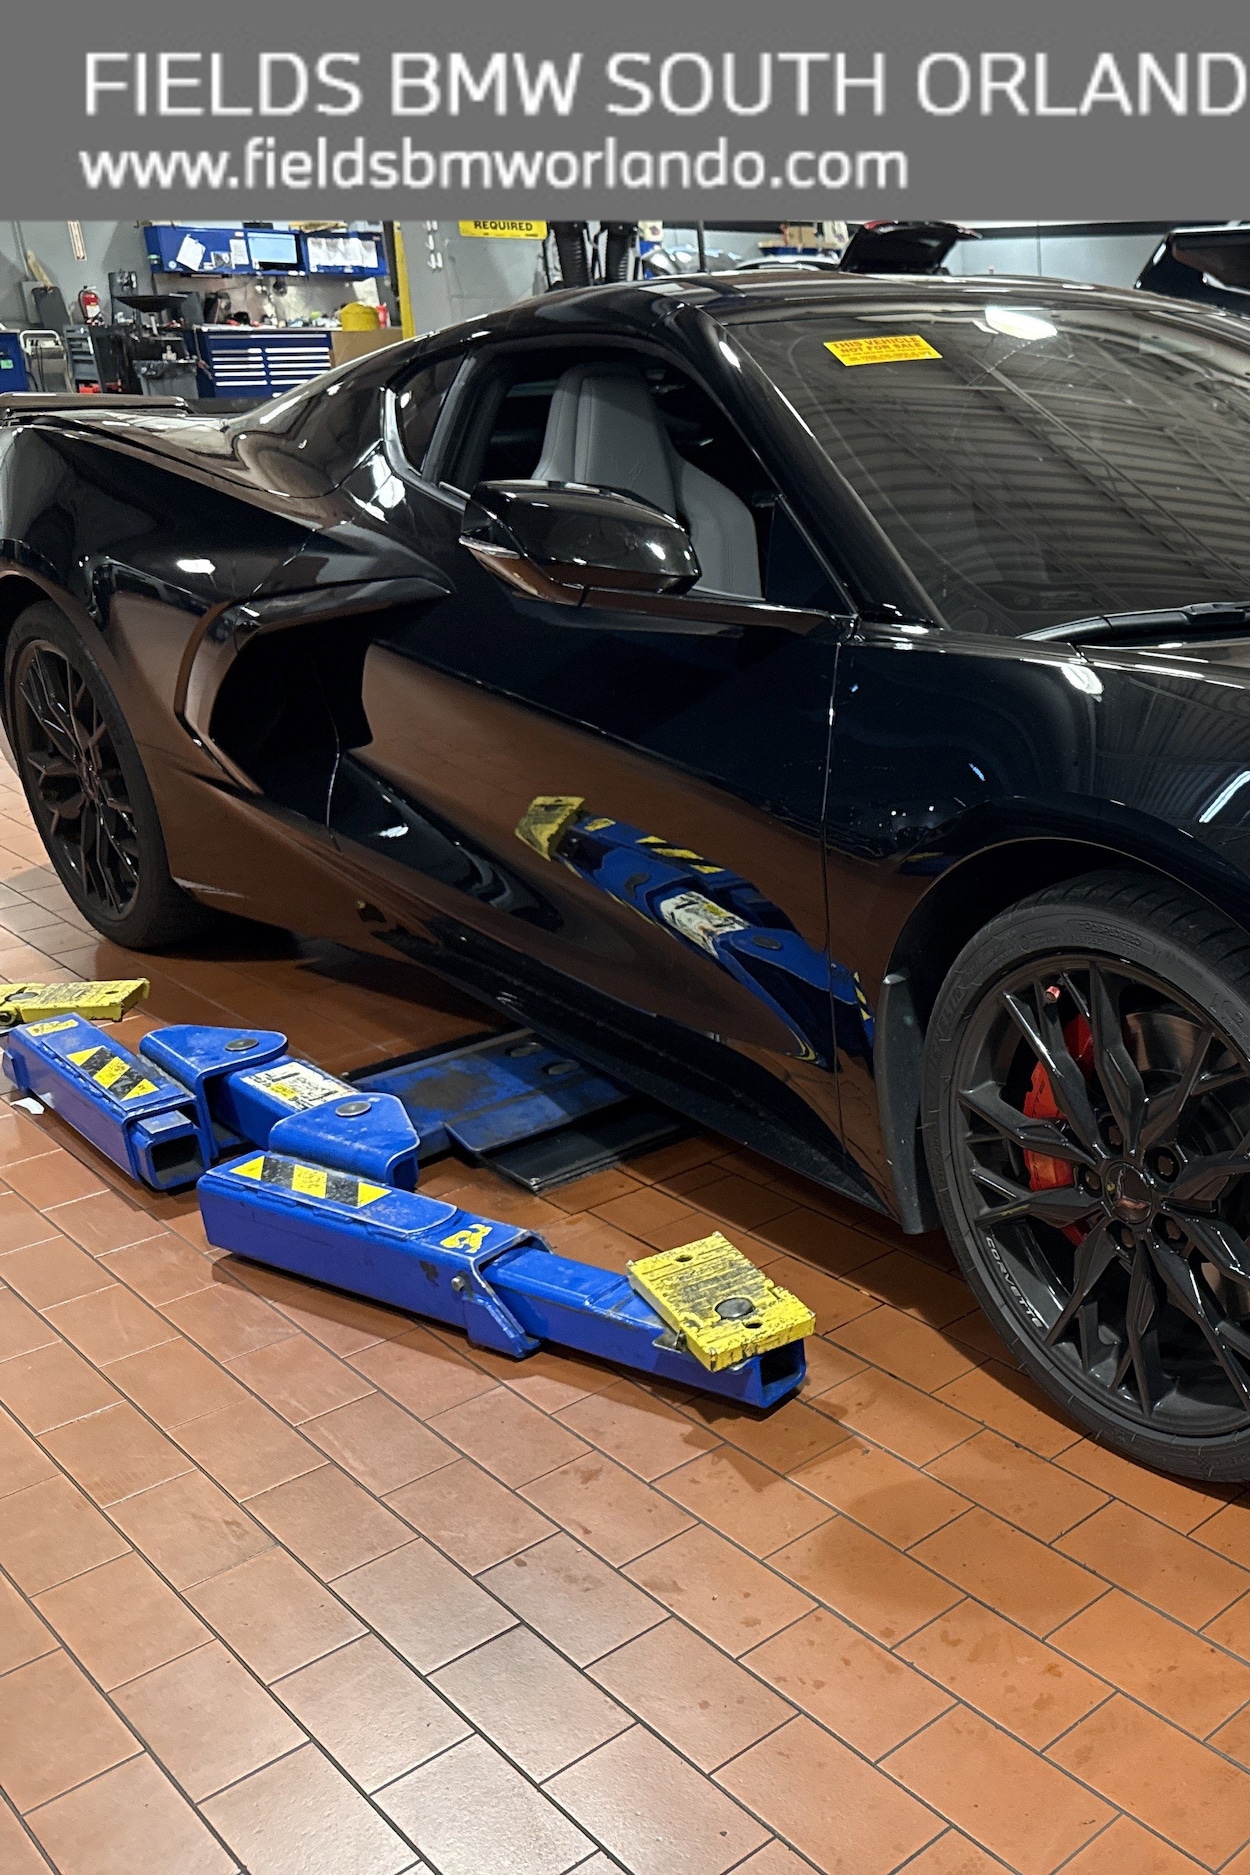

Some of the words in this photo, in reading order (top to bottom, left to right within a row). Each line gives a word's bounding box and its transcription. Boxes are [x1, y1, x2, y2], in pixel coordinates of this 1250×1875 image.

[473, 220, 533, 231] REQUIRED
[832, 341, 863, 349] THIS
[864, 337, 921, 346] VEHICLE
[985, 1236, 1044, 1328] CORVETTE
